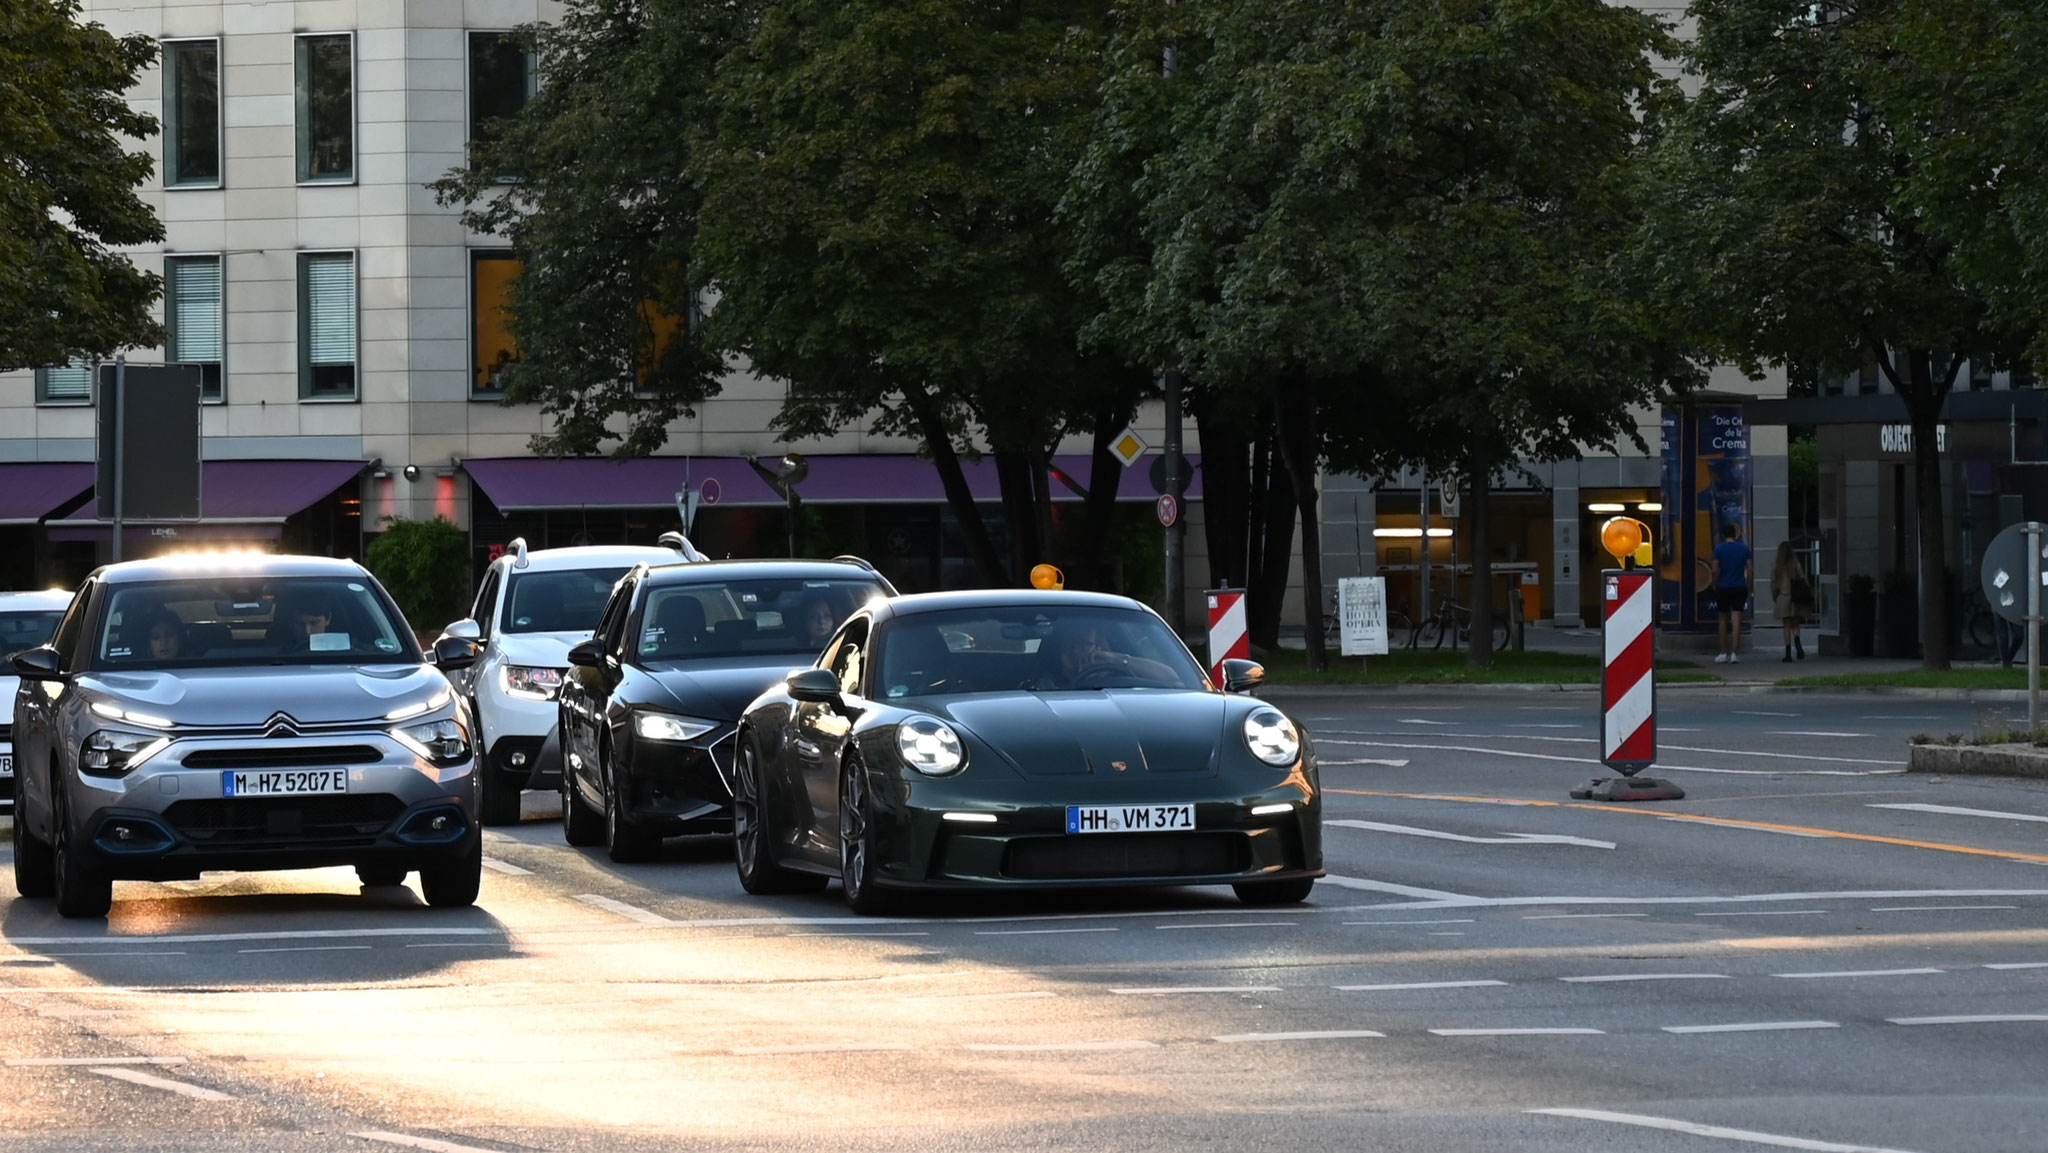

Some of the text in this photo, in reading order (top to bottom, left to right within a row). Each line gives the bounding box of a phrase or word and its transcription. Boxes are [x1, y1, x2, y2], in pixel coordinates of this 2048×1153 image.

[1725, 427, 1735, 437] de
[1712, 437, 1747, 449] Crema
[1881, 424, 1912, 453] OBJECT
[1346, 611, 1380, 620] HOTEL
[1346, 620, 1381, 629] OPERA
